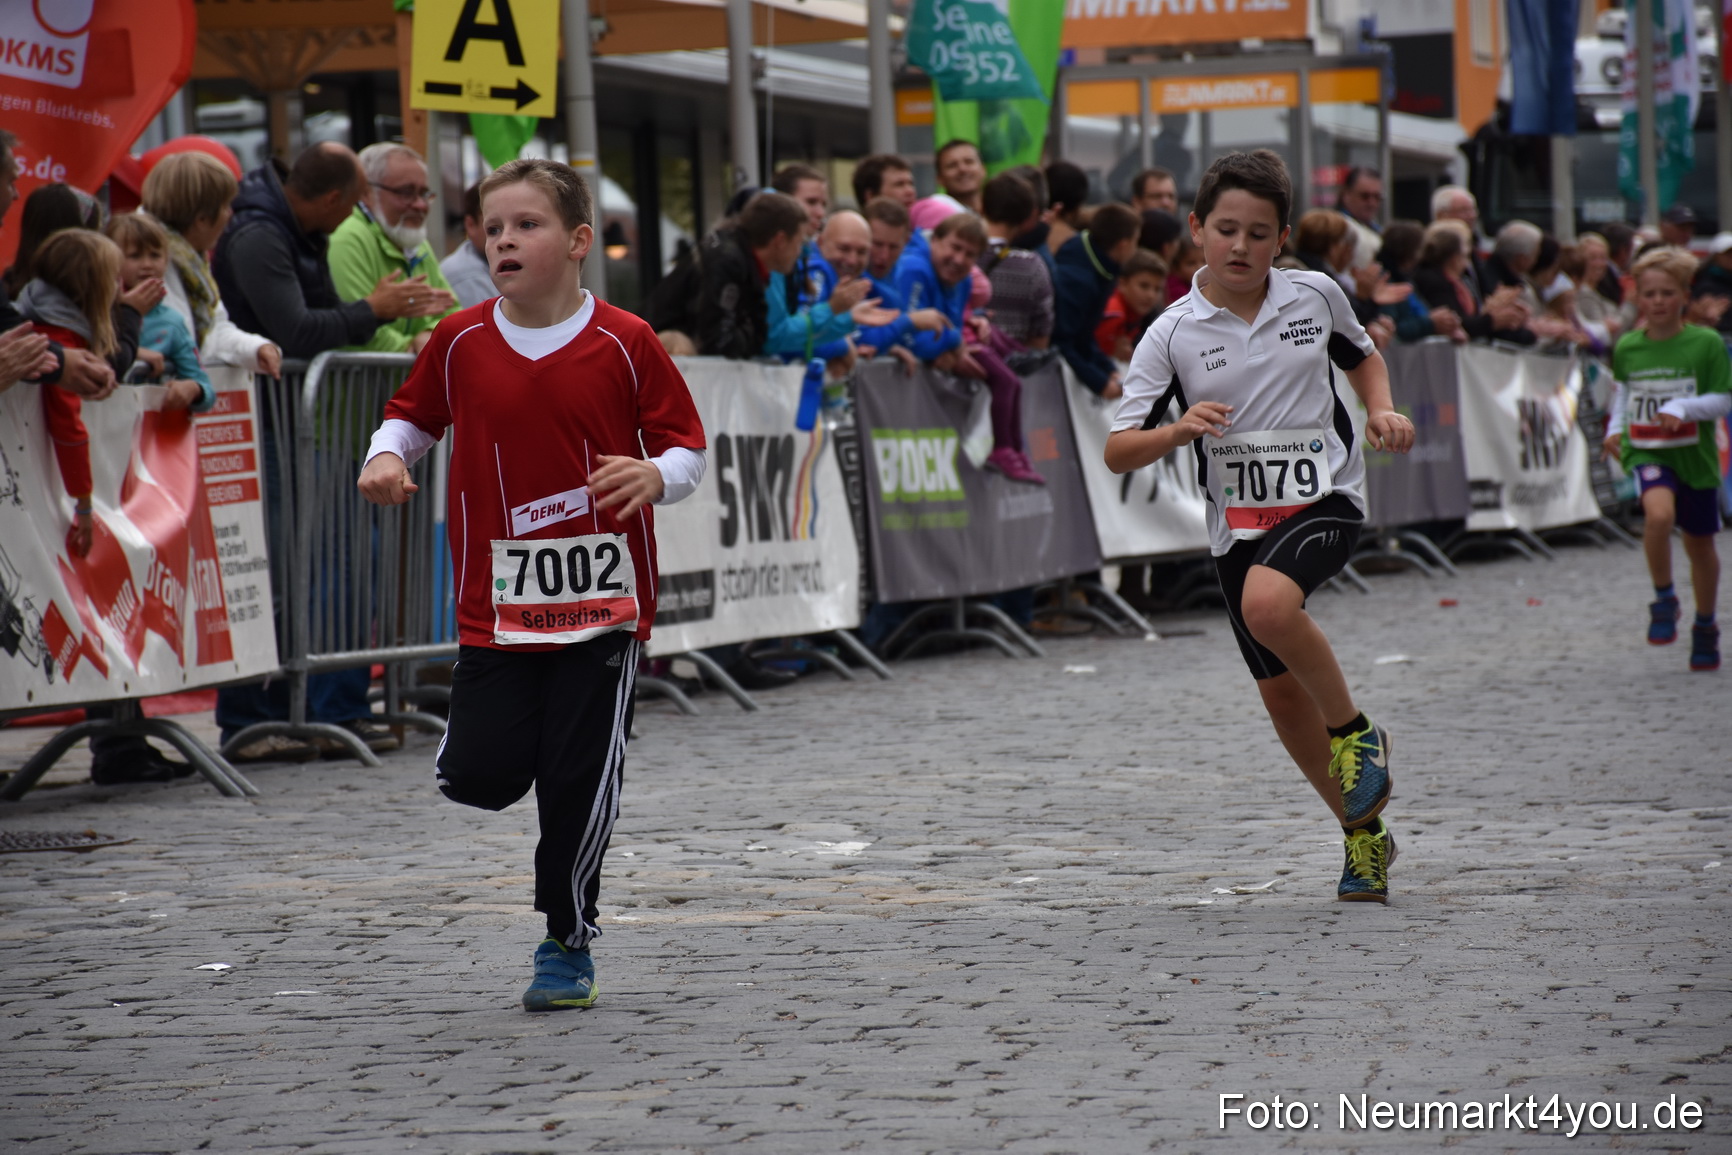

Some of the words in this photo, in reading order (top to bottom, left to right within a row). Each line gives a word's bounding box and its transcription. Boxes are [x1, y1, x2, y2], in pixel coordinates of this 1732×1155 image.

[443, 0, 526, 67] A
[0, 94, 31, 111] gen
[35, 98, 115, 129] Blutkrebs.
[1288, 318, 1313, 328] SPORT
[1279, 326, 1323, 341] MÜNCH
[1294, 338, 1315, 346] BERG
[1208, 346, 1225, 355] JAKO
[1205, 358, 1227, 372] Luis
[1211, 445, 1246, 458] PARTL
[1247, 442, 1305, 454] Neumarkt
[873, 437, 961, 494] BOCK
[1226, 458, 1319, 502] 7079
[530, 500, 566, 523] DEHN
[506, 541, 623, 597] 7002
[498, 594, 504, 602] 4
[624, 586, 630, 595] K
[521, 607, 612, 629] Sebastian
